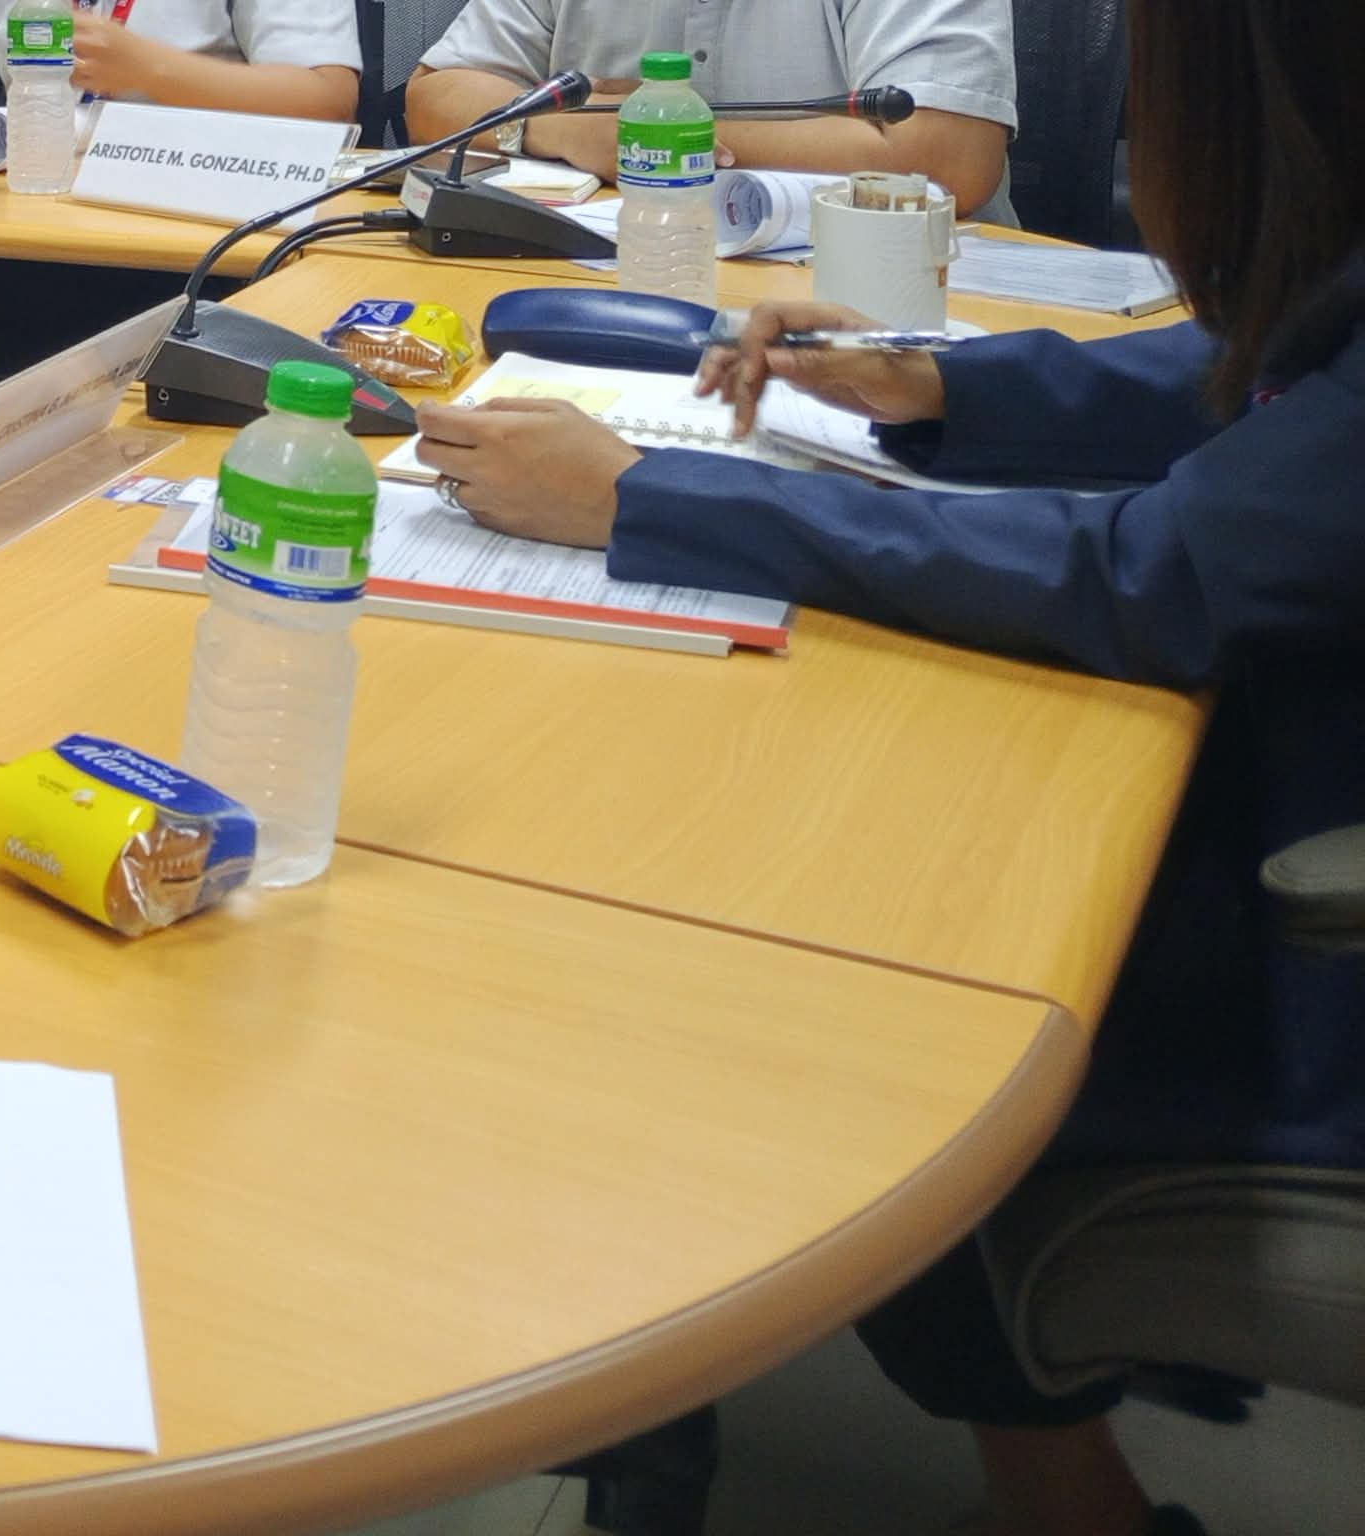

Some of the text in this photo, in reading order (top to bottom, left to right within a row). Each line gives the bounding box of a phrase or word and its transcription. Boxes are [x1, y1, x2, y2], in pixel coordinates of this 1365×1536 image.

[89, 142, 325, 183] ARISTOTLE M. GONZALES, PH.D
[59, 744, 177, 800] Mamon
[105, 748, 189, 785] Special
